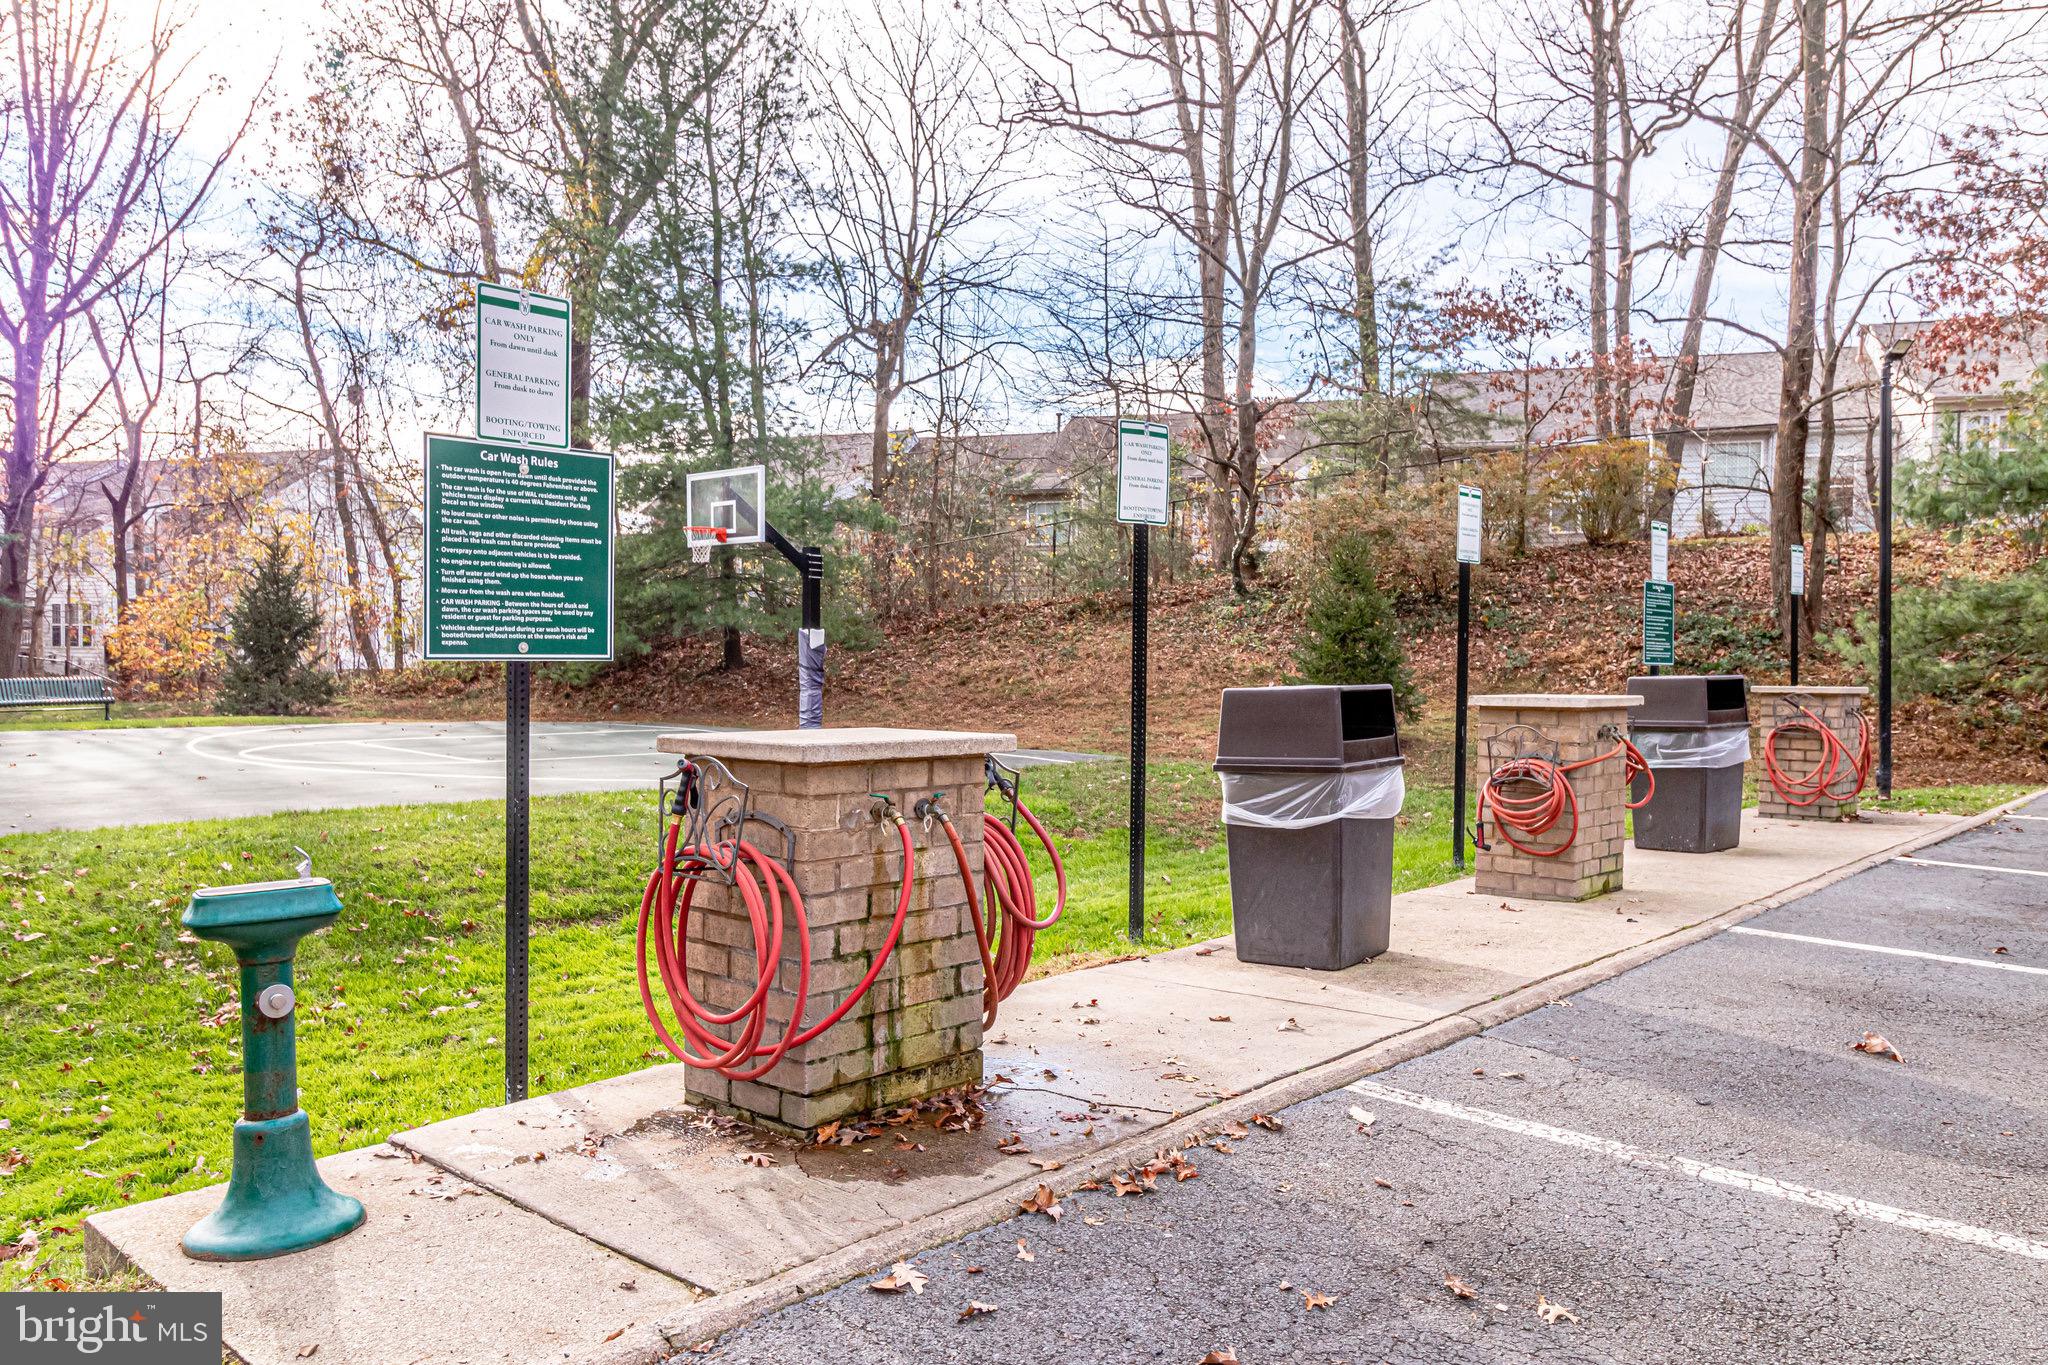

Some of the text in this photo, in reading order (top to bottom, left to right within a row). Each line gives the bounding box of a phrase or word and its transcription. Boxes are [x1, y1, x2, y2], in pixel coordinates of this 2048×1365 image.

[485, 317, 563, 338] CAR WASH PARKING
[514, 333, 535, 343] ONLY
[490, 339, 558, 358] From dawn until dusk
[486, 369, 560, 387] GENERAL PARKING
[494, 381, 511, 390] From
[513, 384, 527, 393] dusk
[537, 388, 554, 396] dawn
[486, 416, 560, 432] BOOTING/TOWING
[502, 429, 545, 440] ENFORCED
[480, 450, 558, 468] Car Wash Rules
[467, 475, 504, 484] temperature
[520, 480, 542, 488] degrees
[543, 482, 573, 490] Fahrenheit
[562, 477, 587, 485] provided
[483, 495, 504, 503] display
[531, 516, 559, 525] permitted
[441, 547, 472, 555] Overspray
